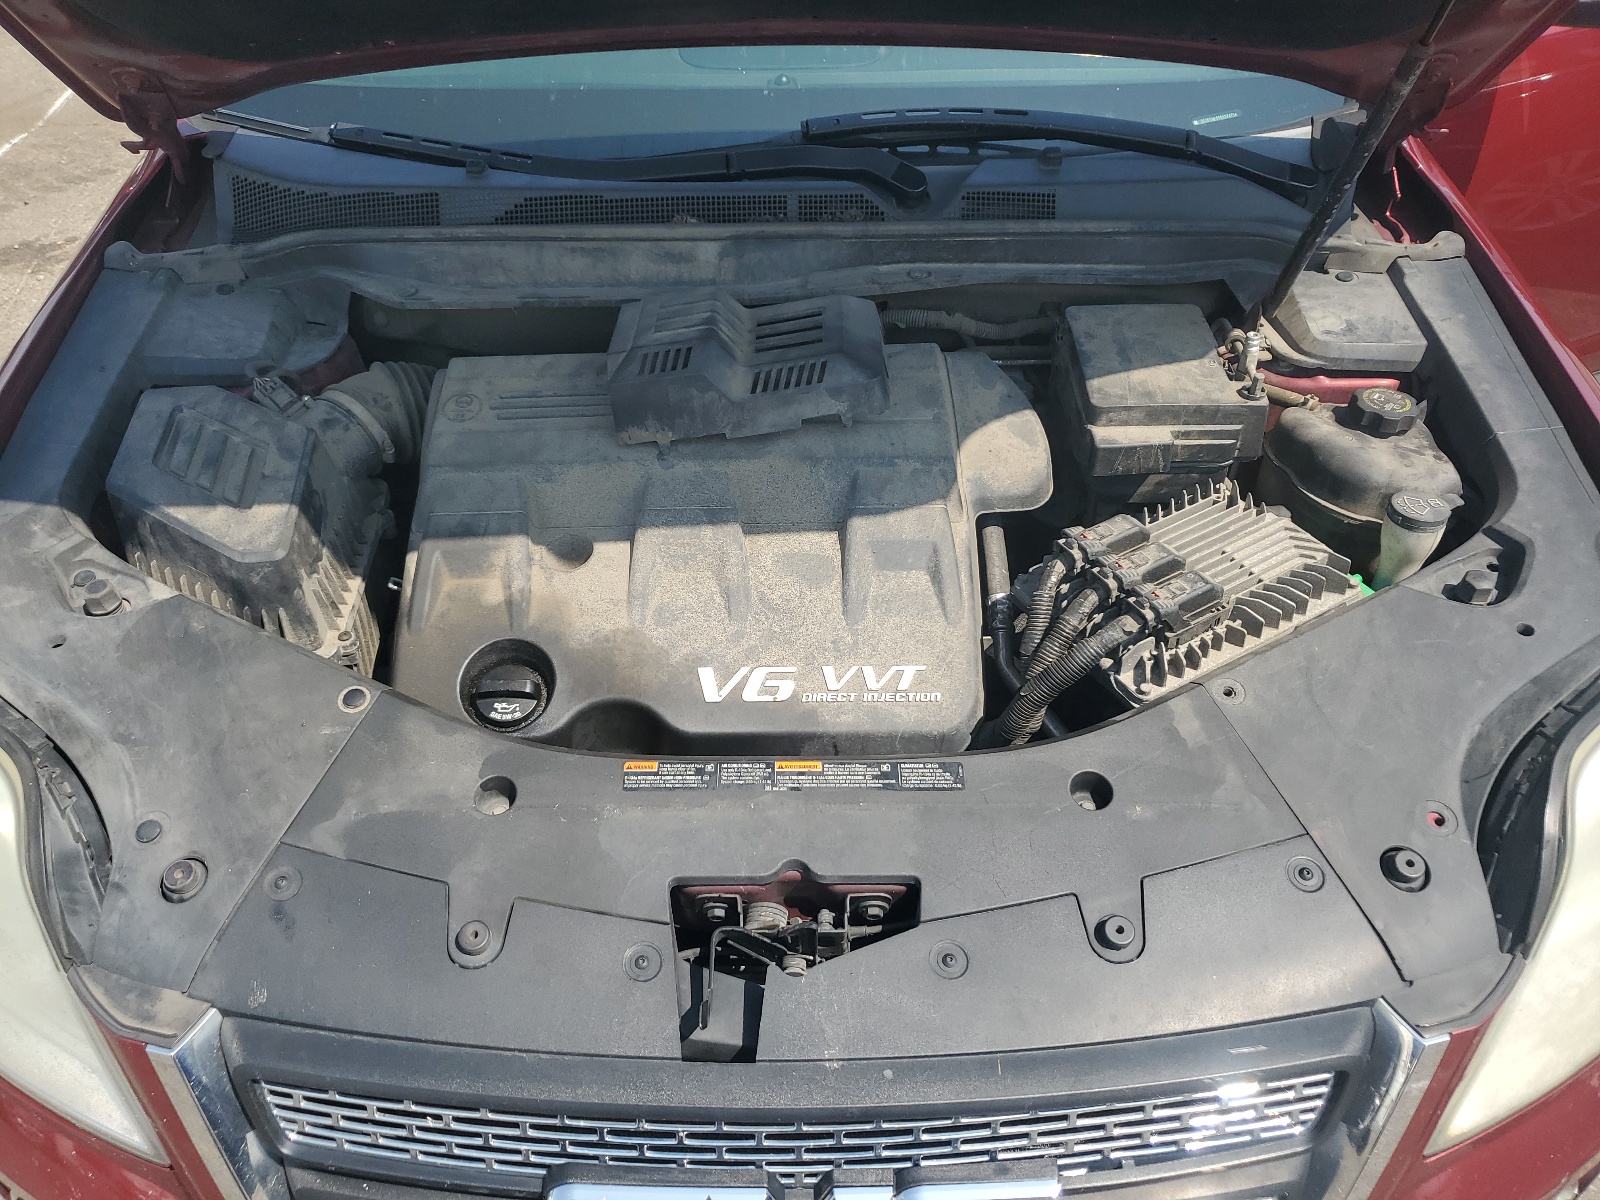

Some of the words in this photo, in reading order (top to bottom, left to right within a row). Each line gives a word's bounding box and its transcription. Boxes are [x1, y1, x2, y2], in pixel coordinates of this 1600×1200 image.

[697, 666, 798, 703] V6
[821, 665, 927, 691] VVT
[801, 692, 857, 703] DIRECT
[862, 692, 941, 703] INJECTION
